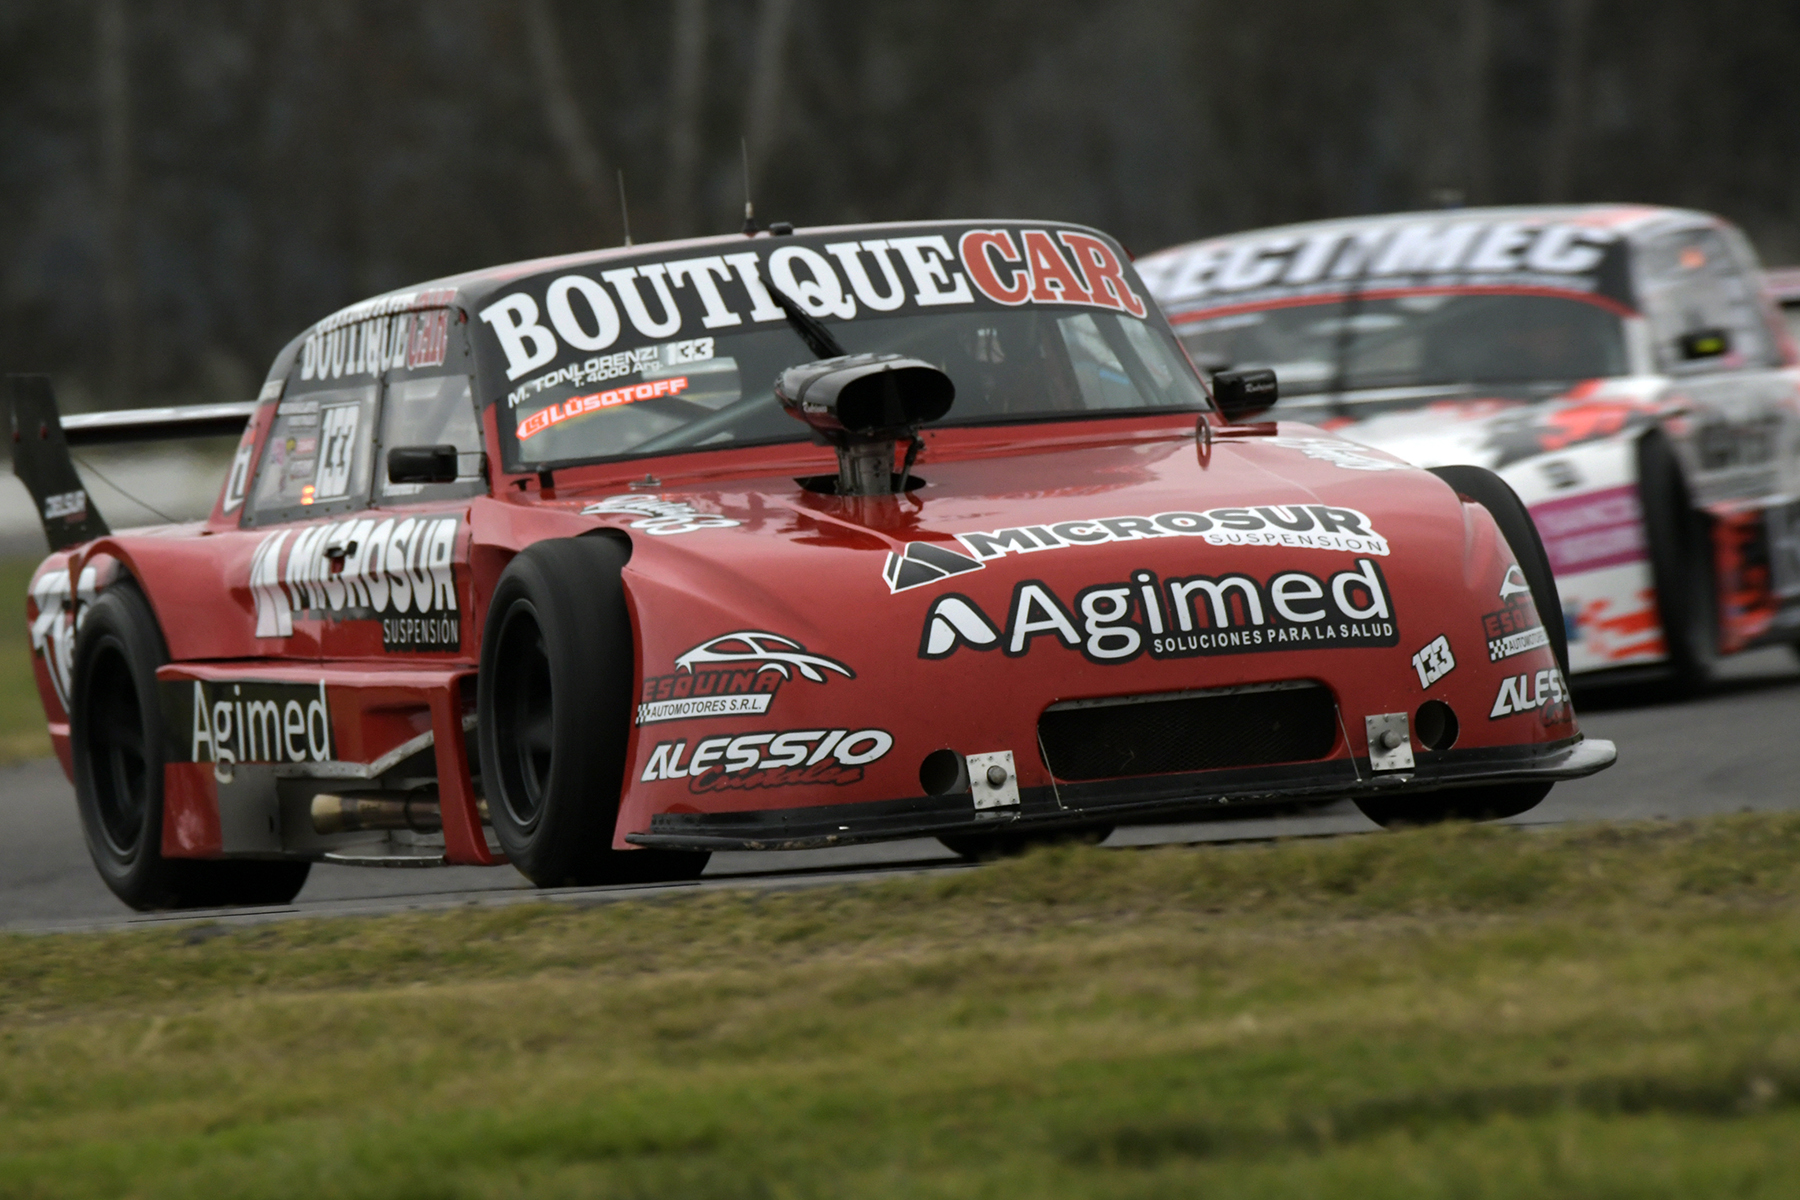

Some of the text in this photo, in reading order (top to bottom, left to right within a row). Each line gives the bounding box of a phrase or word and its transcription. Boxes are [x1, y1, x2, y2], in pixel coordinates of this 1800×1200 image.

[508, 337, 714, 409] M. TONLORENZI 133
[587, 364, 630, 383] 4000
[632, 359, 664, 373] Arg.
[961, 505, 1374, 558] MICROSUR
[1209, 532, 1383, 552] SUSPENSION
[383, 612, 459, 644] SUSPENSIÓN
[1009, 558, 1390, 659] Agimed
[1153, 622, 1393, 654] SOLUCIONES PARA LA SALUD
[1412, 635, 1456, 690] 133
[645, 670, 782, 700] ESQUINA
[651, 698, 762, 718] AUTOMOTORES S.R.L.
[191, 678, 331, 784] Agimed
[640, 729, 894, 783] ALESSIO
